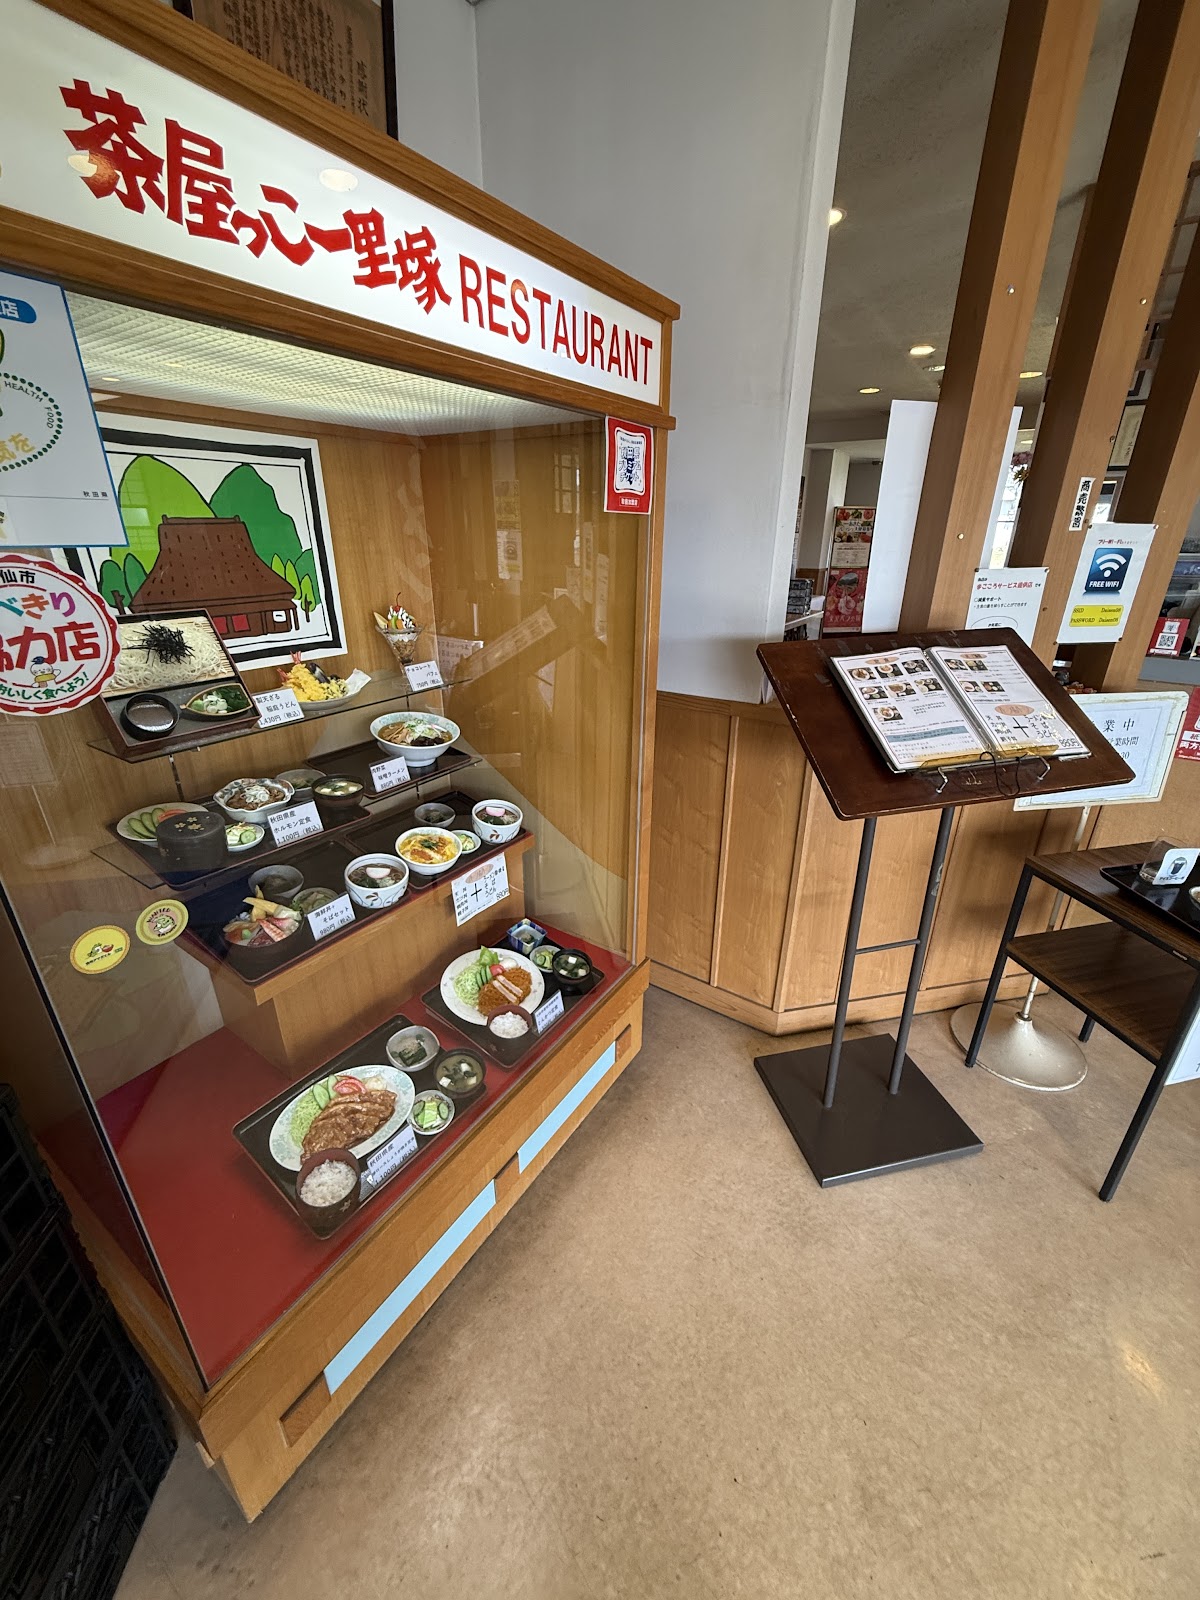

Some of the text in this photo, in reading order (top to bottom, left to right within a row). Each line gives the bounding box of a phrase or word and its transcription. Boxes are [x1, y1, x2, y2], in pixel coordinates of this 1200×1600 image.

[59, 78, 654, 387] 茶屋っこ一里塚 RESTAURANT
[0, 300, 20, 319] 店
[4, 380, 55, 429] HEALTH FOOD
[1089, 580, 1120, 588] FREE WIFI
[1092, 716, 1136, 733] 業中
[1178, 740, 1200, 751] 両方
[270, 810, 297, 824] 秋田県産
[274, 816, 312, 834] ホルモン定食
